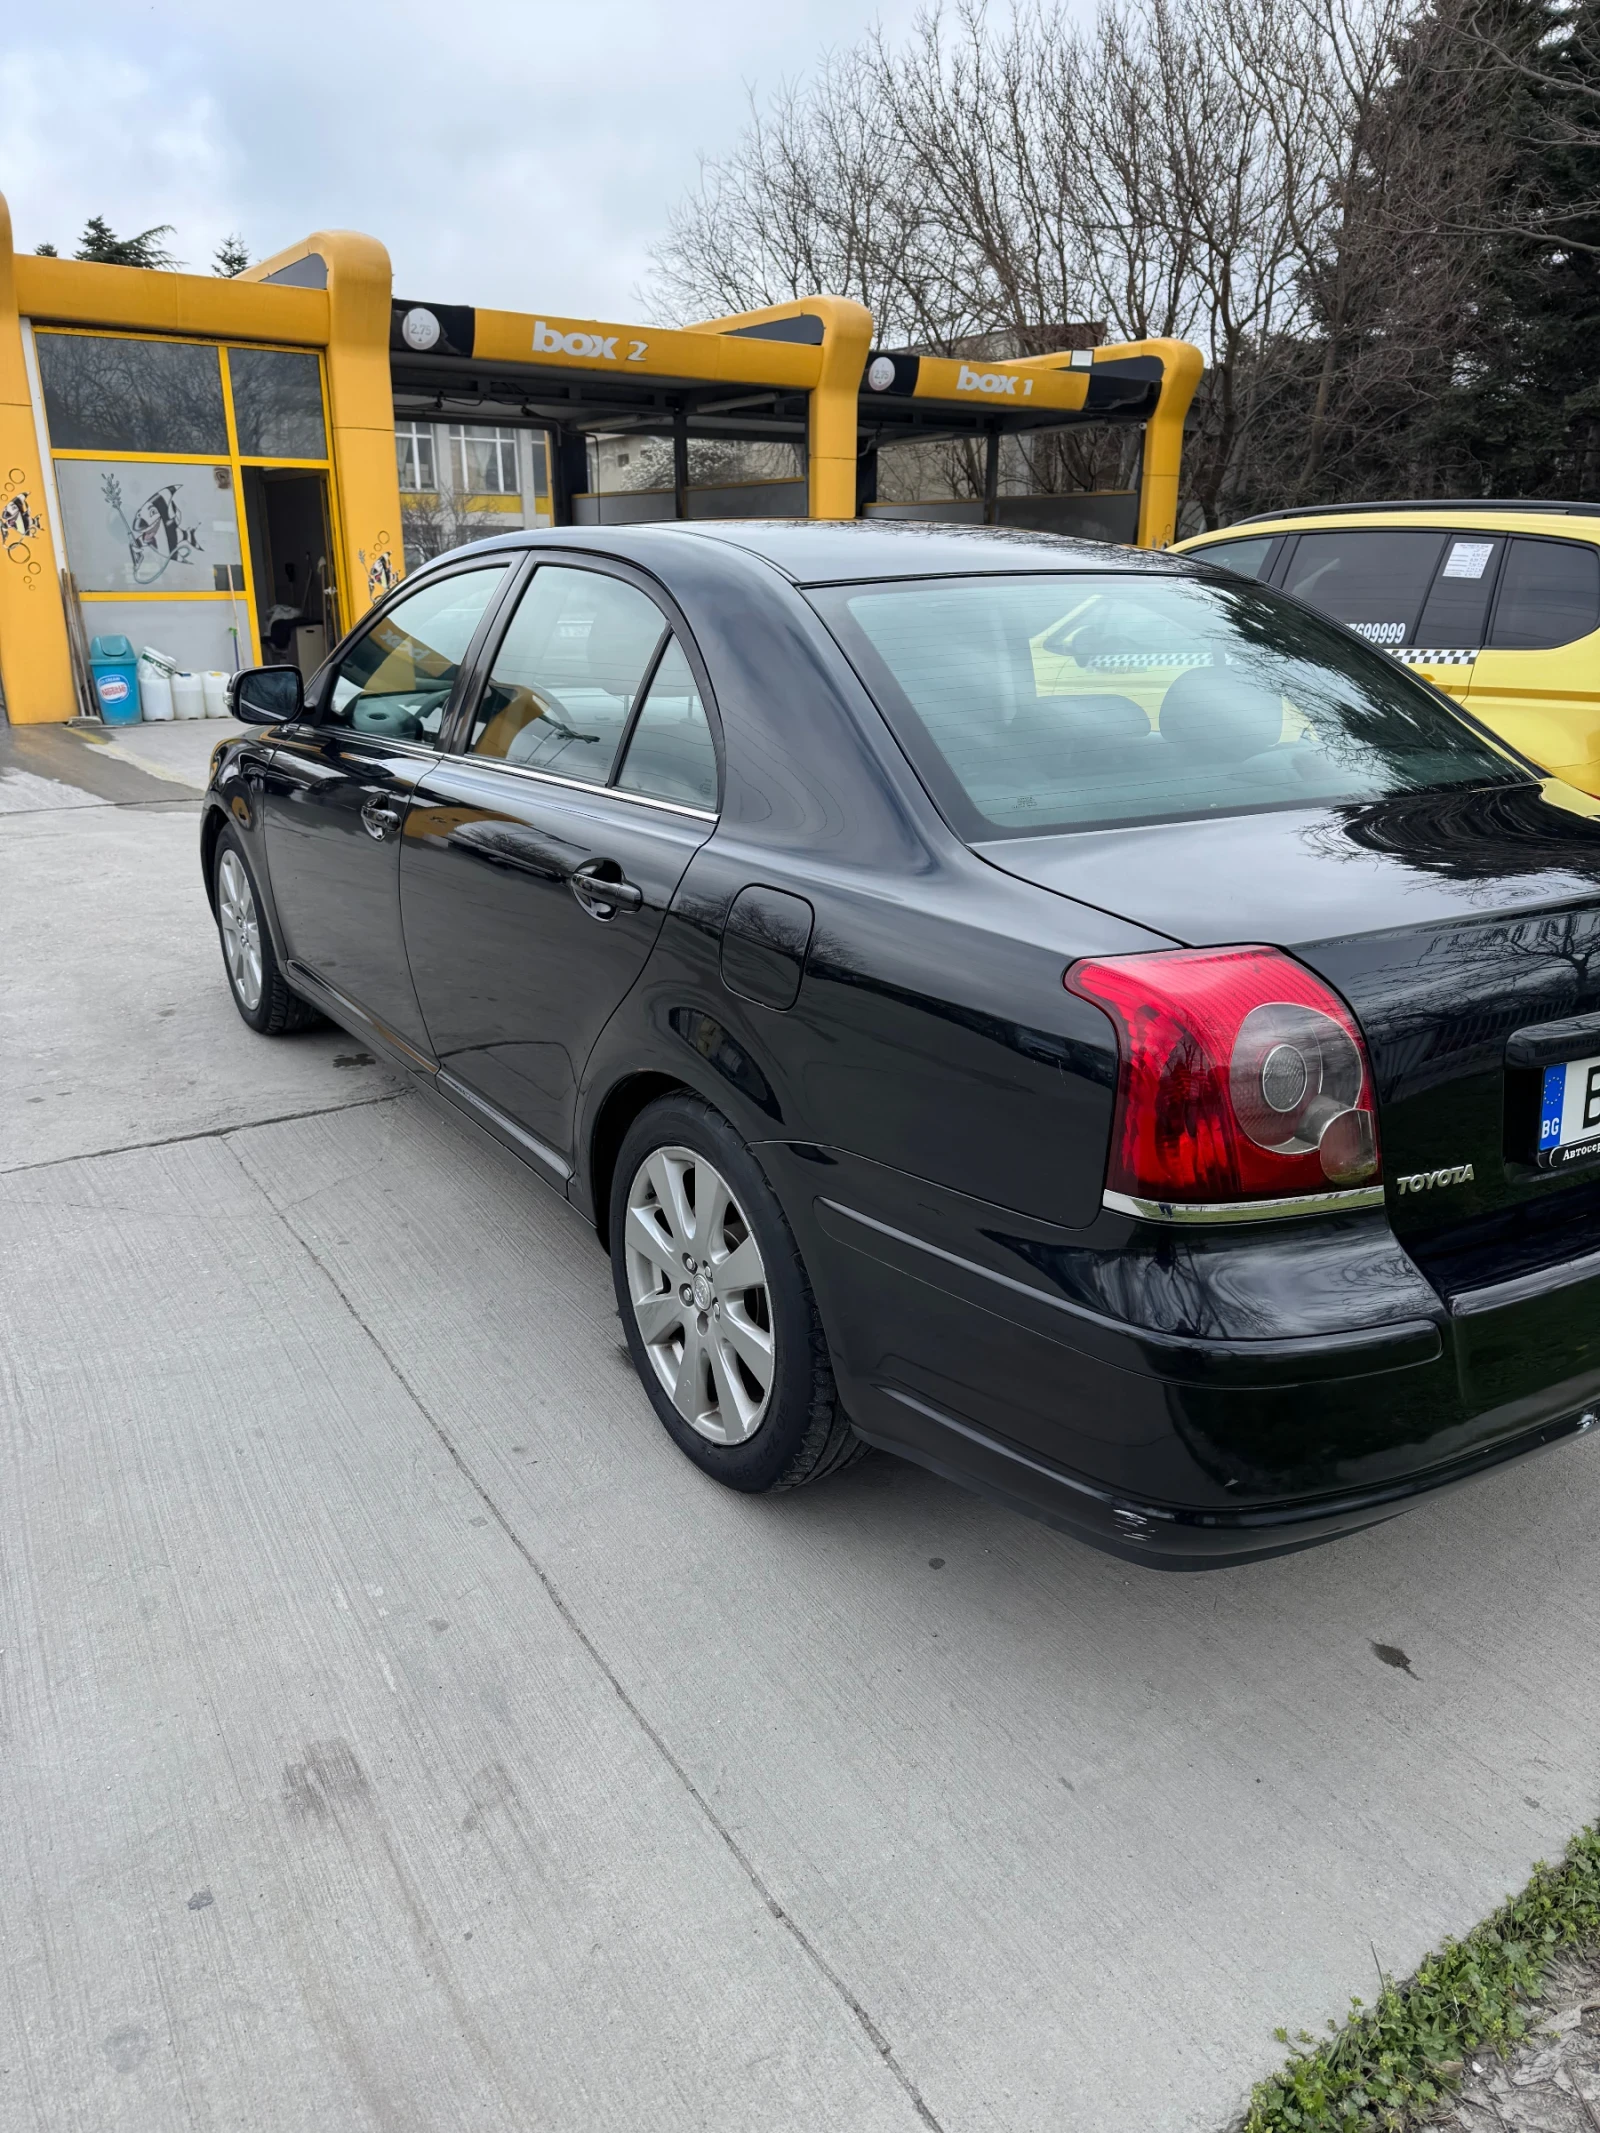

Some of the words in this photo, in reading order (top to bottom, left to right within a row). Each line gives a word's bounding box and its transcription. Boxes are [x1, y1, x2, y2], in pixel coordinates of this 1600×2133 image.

[410, 323, 432, 336] 2.75
[532, 320, 619, 360] box
[626, 340, 649, 361] 2
[956, 365, 1019, 395] box
[1023, 379, 1034, 396] 1
[1541, 1117, 1560, 1139] BG
[1397, 1164, 1475, 1195] TOYOTA
